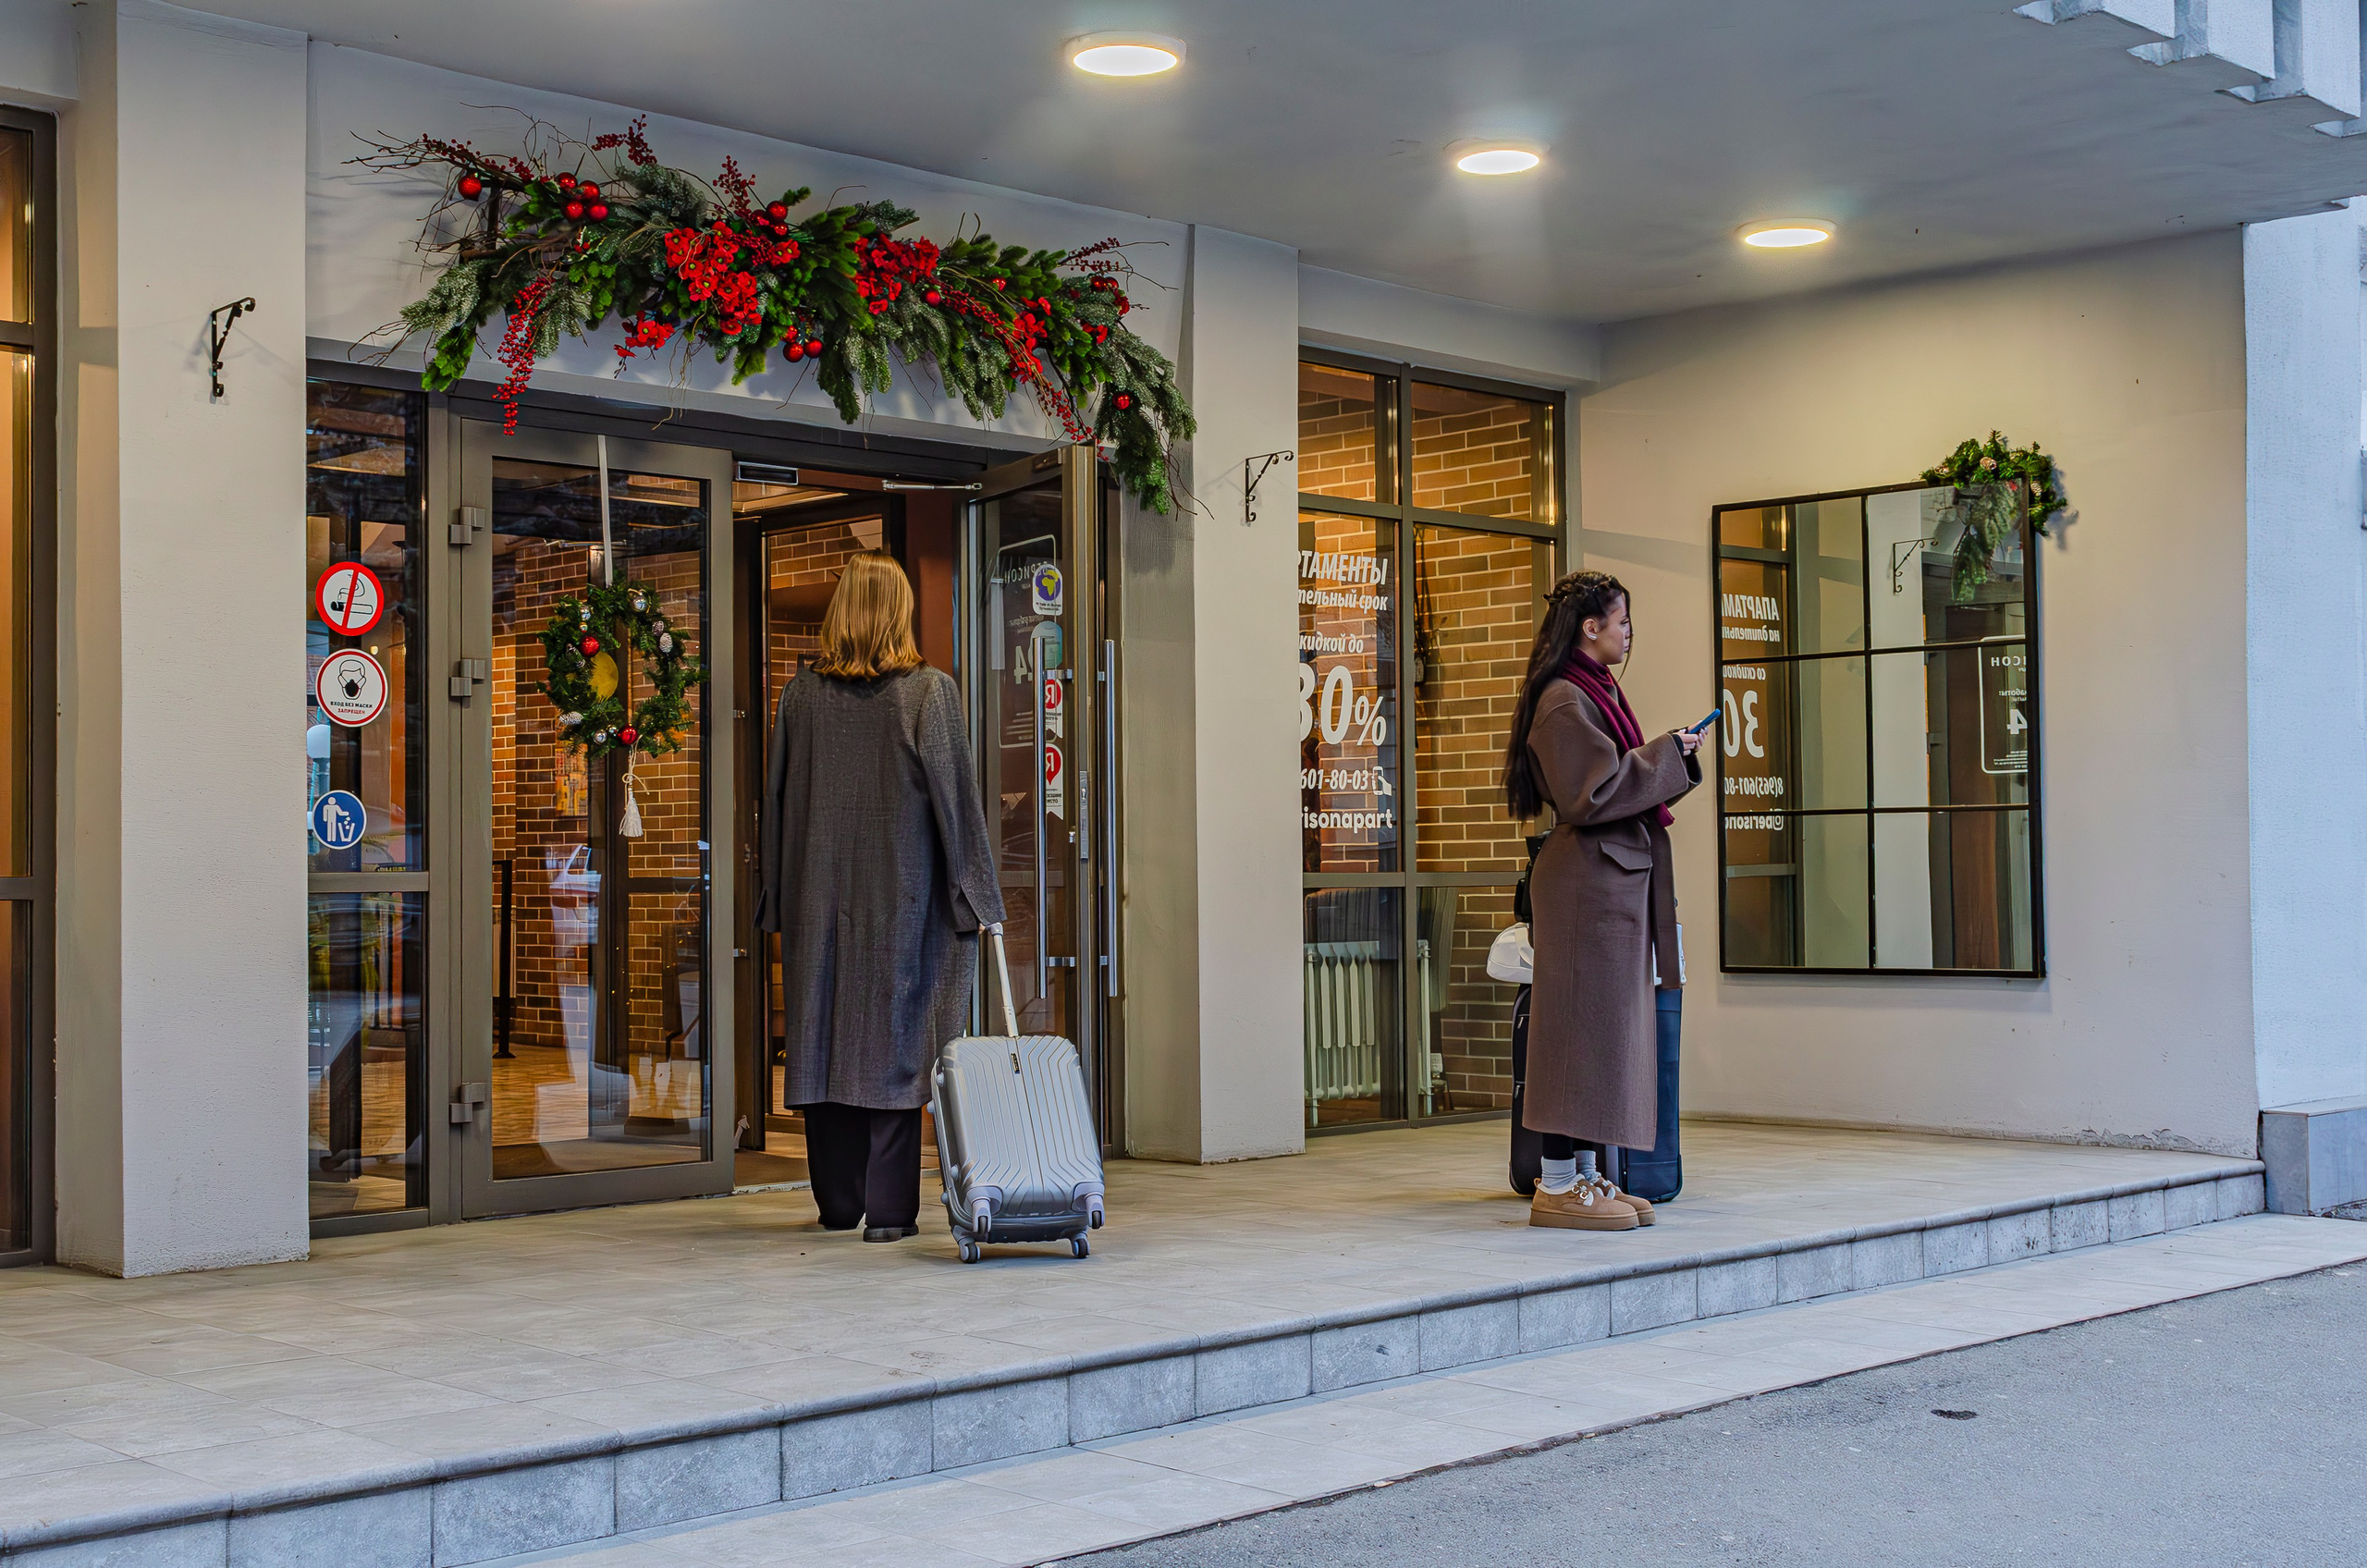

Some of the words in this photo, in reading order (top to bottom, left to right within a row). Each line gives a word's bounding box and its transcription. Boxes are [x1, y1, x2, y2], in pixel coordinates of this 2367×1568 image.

[1359, 594, 1388, 614] срок
[1348, 633, 1364, 654] до
[1301, 806, 1392, 833] isonapart
